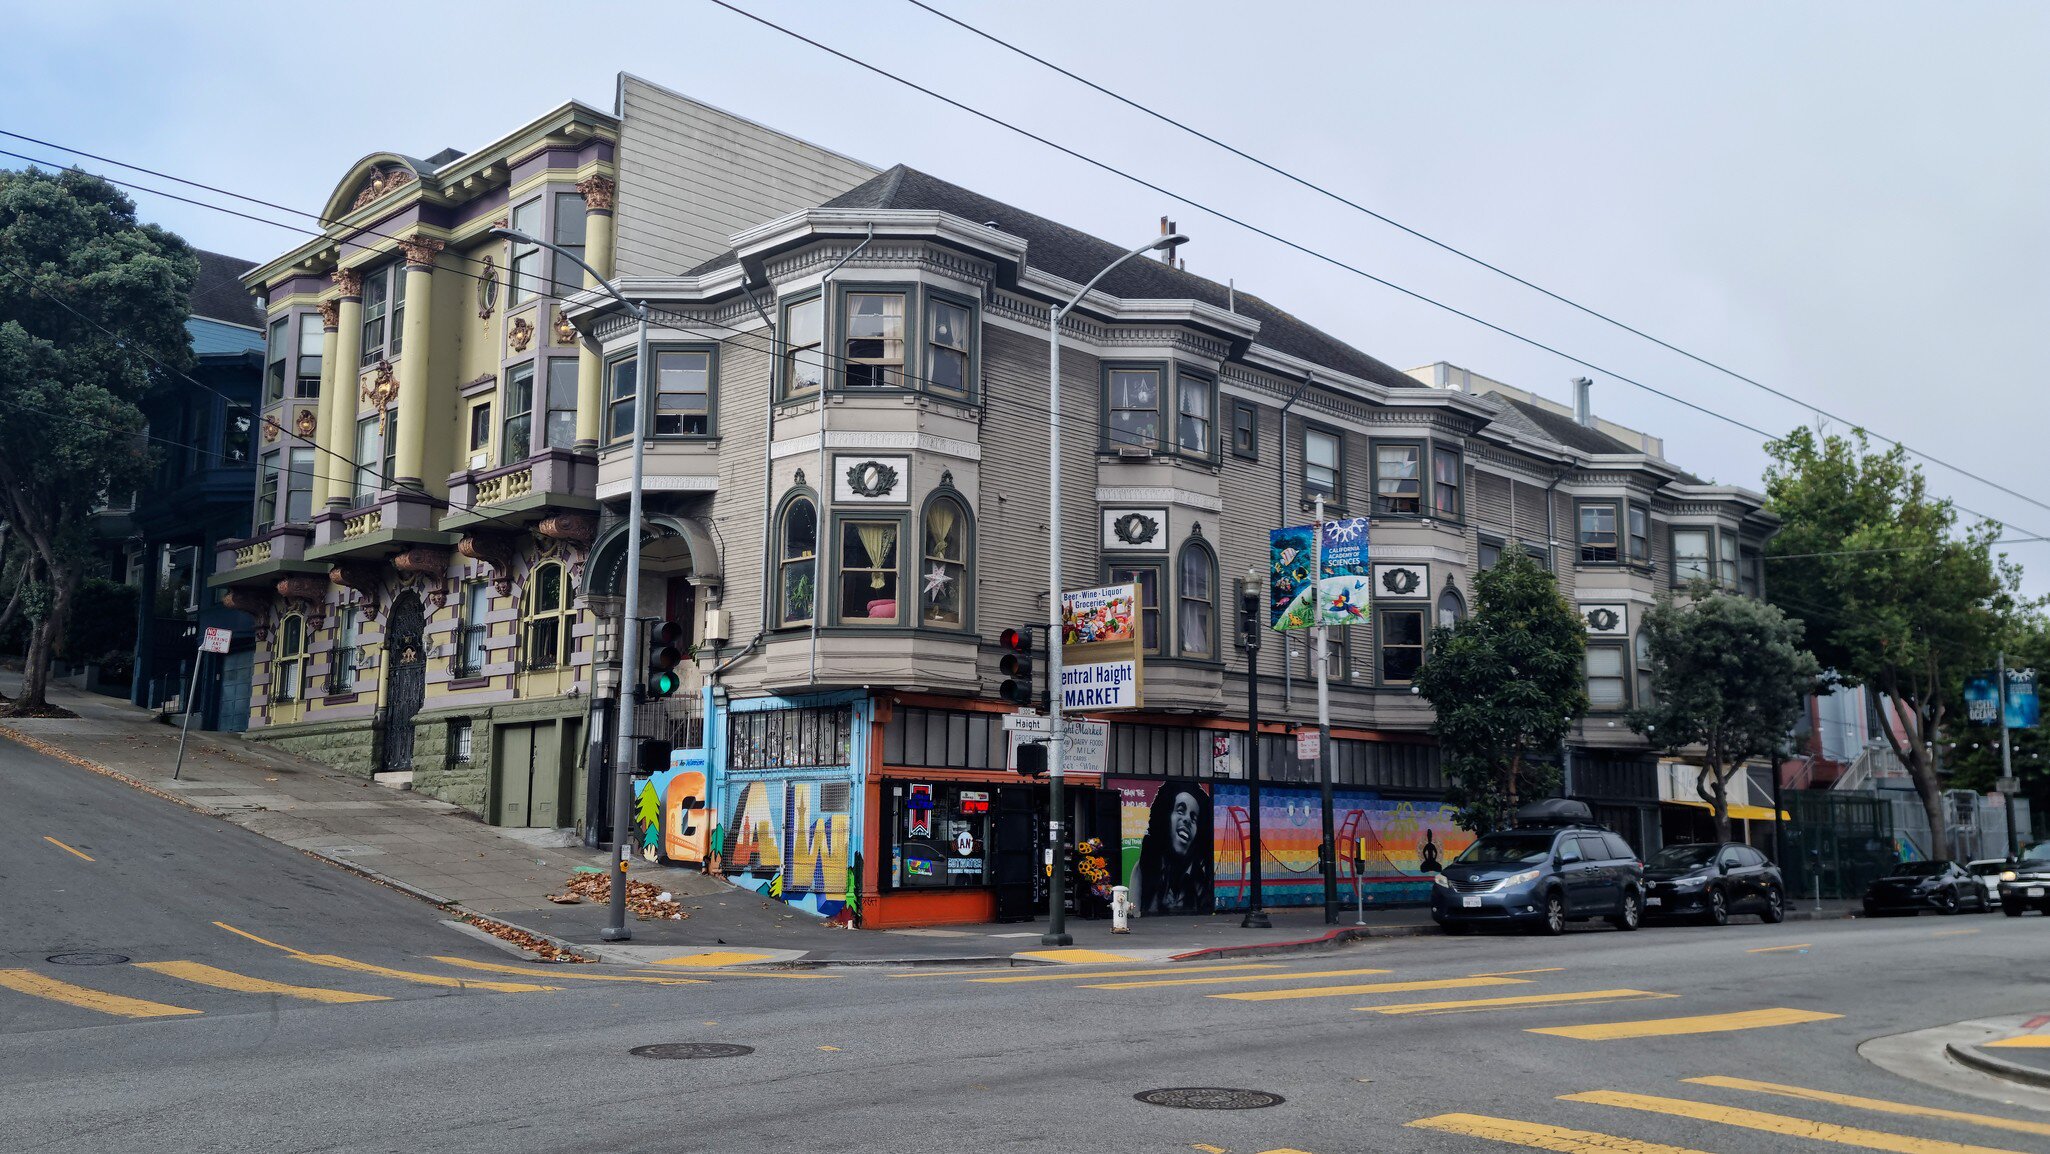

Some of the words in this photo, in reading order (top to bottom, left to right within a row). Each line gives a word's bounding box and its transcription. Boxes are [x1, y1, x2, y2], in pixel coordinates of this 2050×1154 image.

[1328, 546, 1360, 554] CALIFORNIA
[1328, 558, 1361, 566] SCIENCES
[1063, 593, 1078, 601] Beer
[1081, 591, 1097, 599] Wine
[1101, 588, 1122, 598] Liquor
[1075, 600, 1106, 609] Groceries
[208, 628, 217, 636] NO
[1062, 667, 1092, 685] entral
[1096, 665, 1132, 685] Haight
[1065, 687, 1120, 707] MARKET
[1969, 709, 1997, 720] OCEANS
[1015, 719, 1040, 731] Haight
[1063, 724, 1074, 734] ght
[1075, 723, 1103, 736] Market
[1089, 739, 1104, 747] FOODS
[1076, 747, 1096, 755] MILK
[1080, 762, 1100, 771] Wine
[1117, 909, 1124, 918] 8
